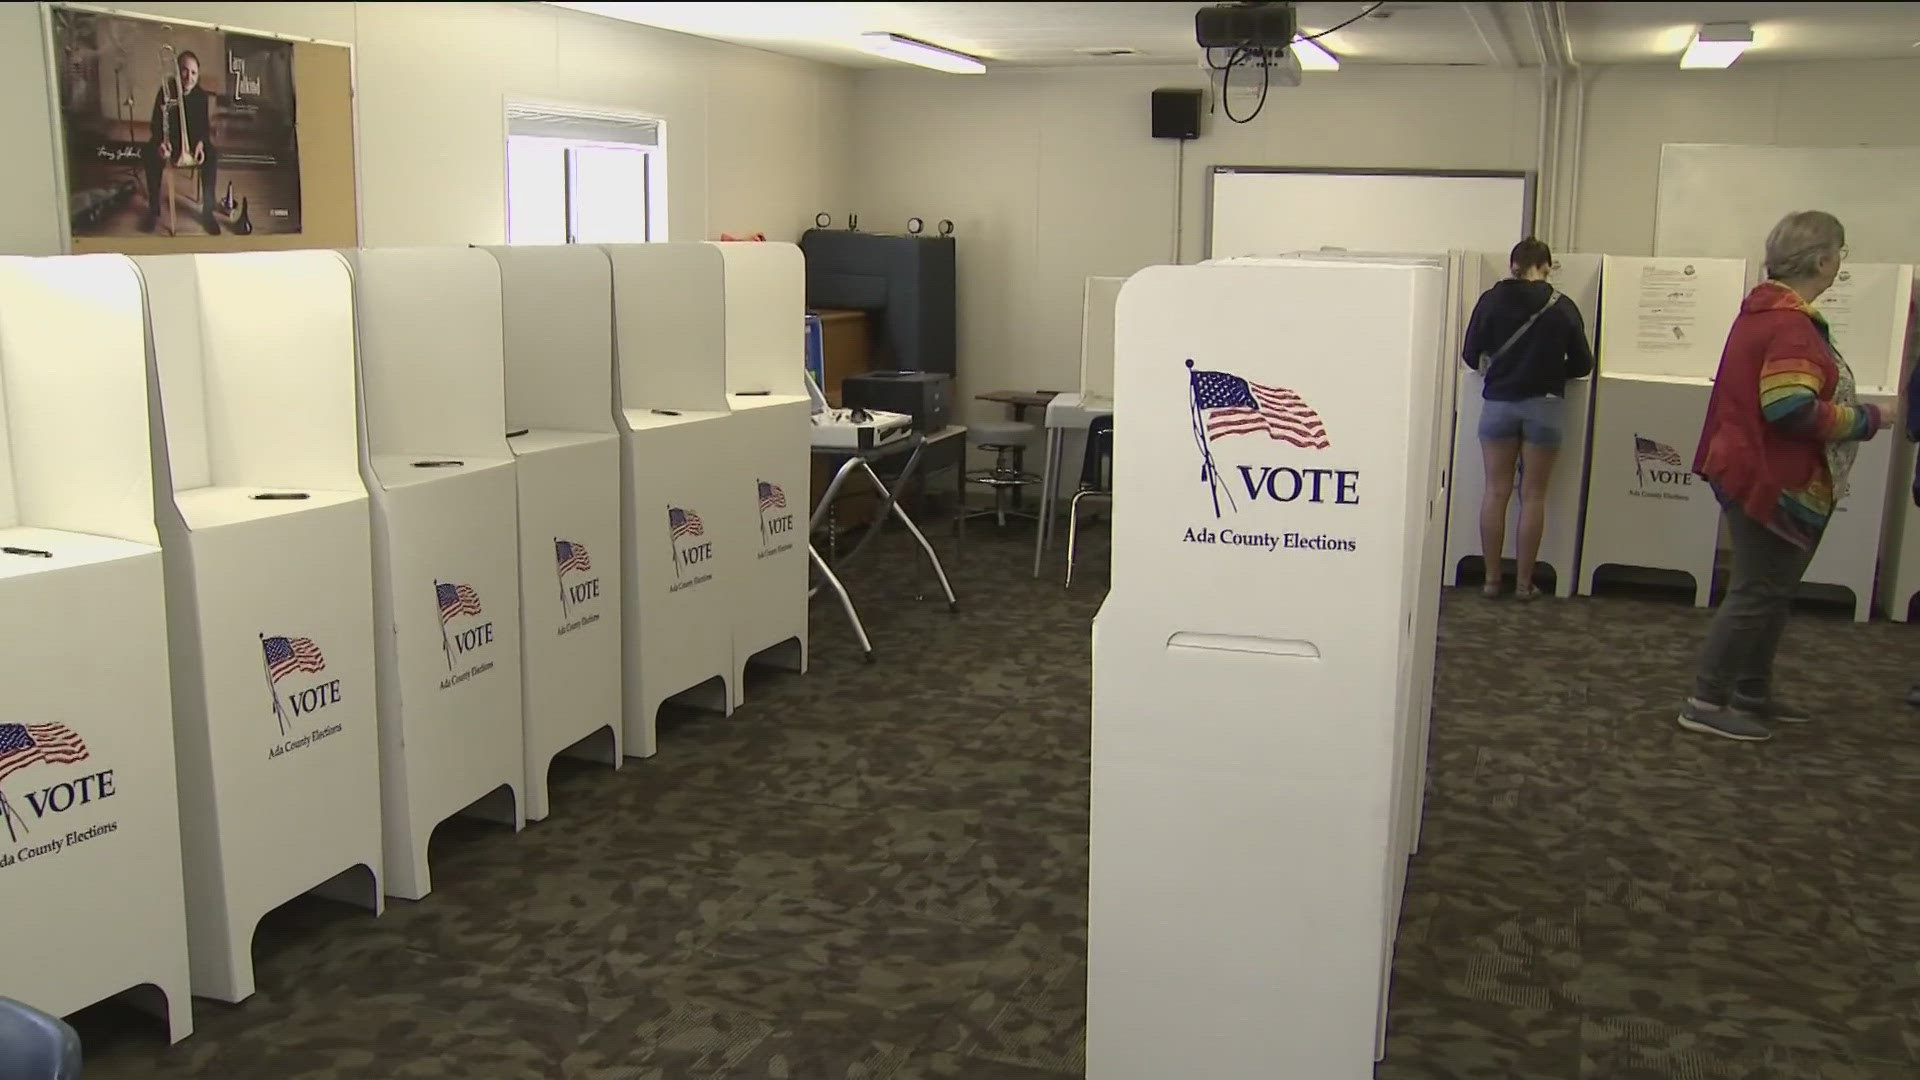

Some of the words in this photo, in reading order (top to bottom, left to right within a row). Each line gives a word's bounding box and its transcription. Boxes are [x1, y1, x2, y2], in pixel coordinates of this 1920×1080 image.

[1237, 465, 1360, 505] VOTE
[1649, 470, 1692, 486] VOTE
[768, 514, 793, 536] VOTE
[1182, 527, 1216, 544] Ada
[1220, 529, 1280, 552] County
[1283, 532, 1356, 552] Elections
[682, 541, 712, 566] VOTE
[569, 577, 600, 605] VOTE
[455, 621, 493, 654] VOTE
[289, 679, 342, 718] VOTE
[268, 744, 284, 760] Ada
[284, 735, 311, 752] County
[312, 723, 342, 742] Elections
[24, 769, 116, 818] VOTE
[0, 854, 15, 868] da
[17, 838, 64, 862] County
[66, 821, 118, 847] Elections
